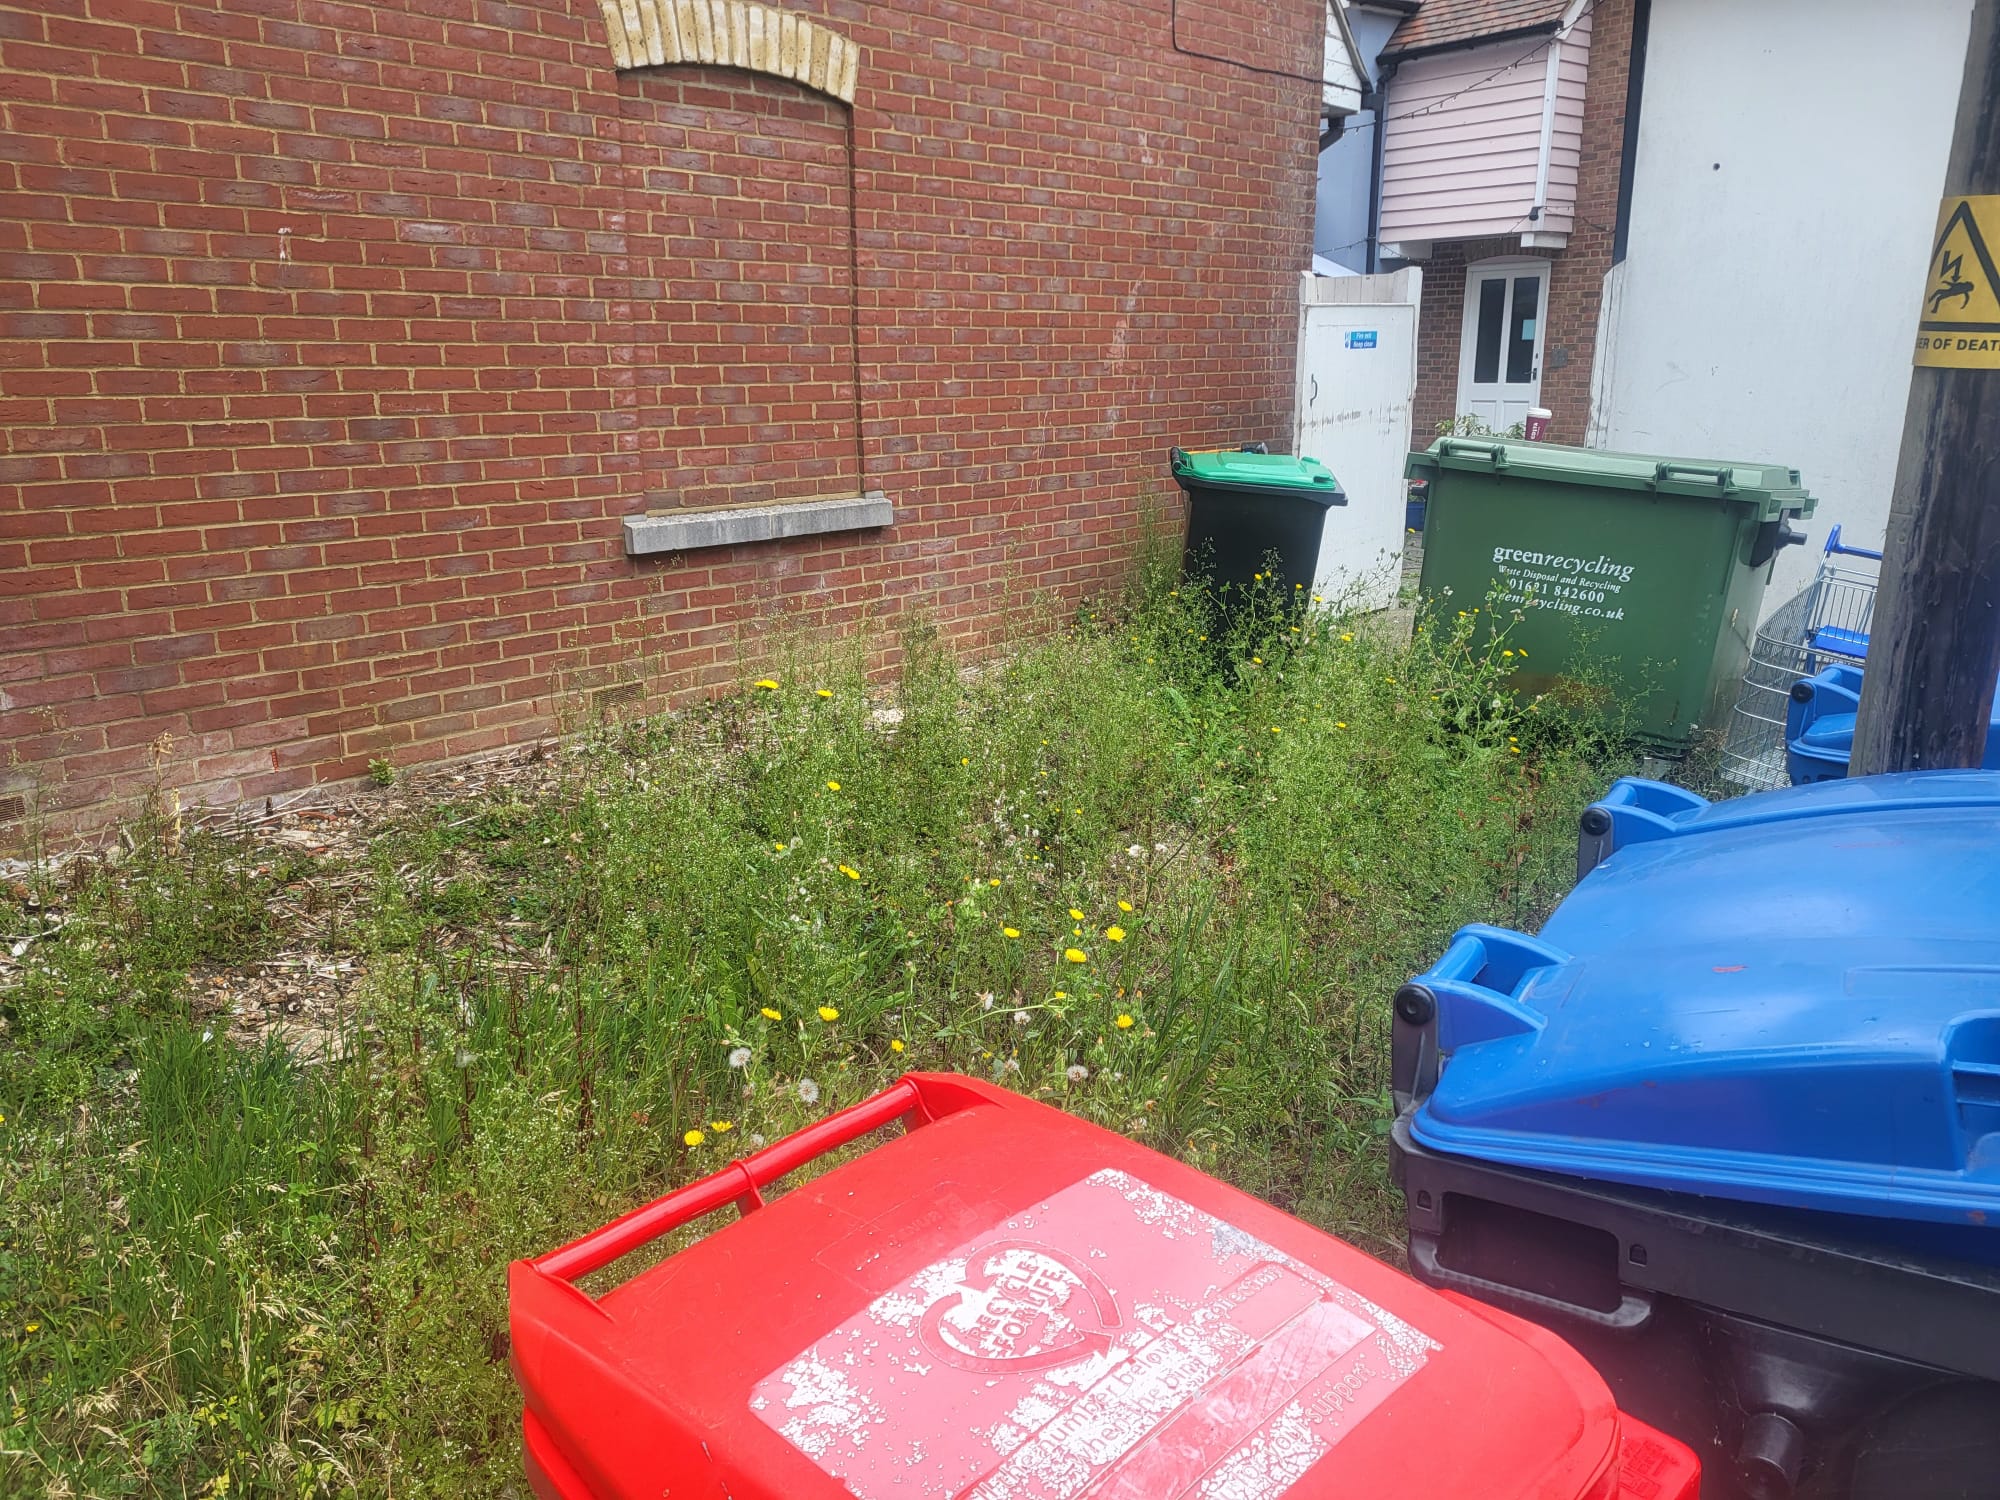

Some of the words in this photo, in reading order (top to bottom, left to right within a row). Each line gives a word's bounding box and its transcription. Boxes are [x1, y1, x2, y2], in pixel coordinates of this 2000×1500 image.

[1933, 337, 1952, 350] OF
[1956, 338, 2000, 351] DEAT
[1493, 547, 1635, 582] greenrecycling
[1523, 568, 1559, 582] Disposal
[1560, 576, 1578, 585] and
[1579, 577, 1621, 594] Recycling
[1485, 590, 1625, 620] greenrycling.co.uk
[1509, 578, 1547, 594] 01621
[1554, 585, 1605, 603] 842600
[967, 1260, 1039, 1340] RECYCLE
[992, 1307, 1040, 1351] FOR
[1027, 1268, 1065, 1307] LIFE
[1039, 1384, 1118, 1453] number
[1112, 1338, 1178, 1387] below
[1304, 1361, 1377, 1426] support
